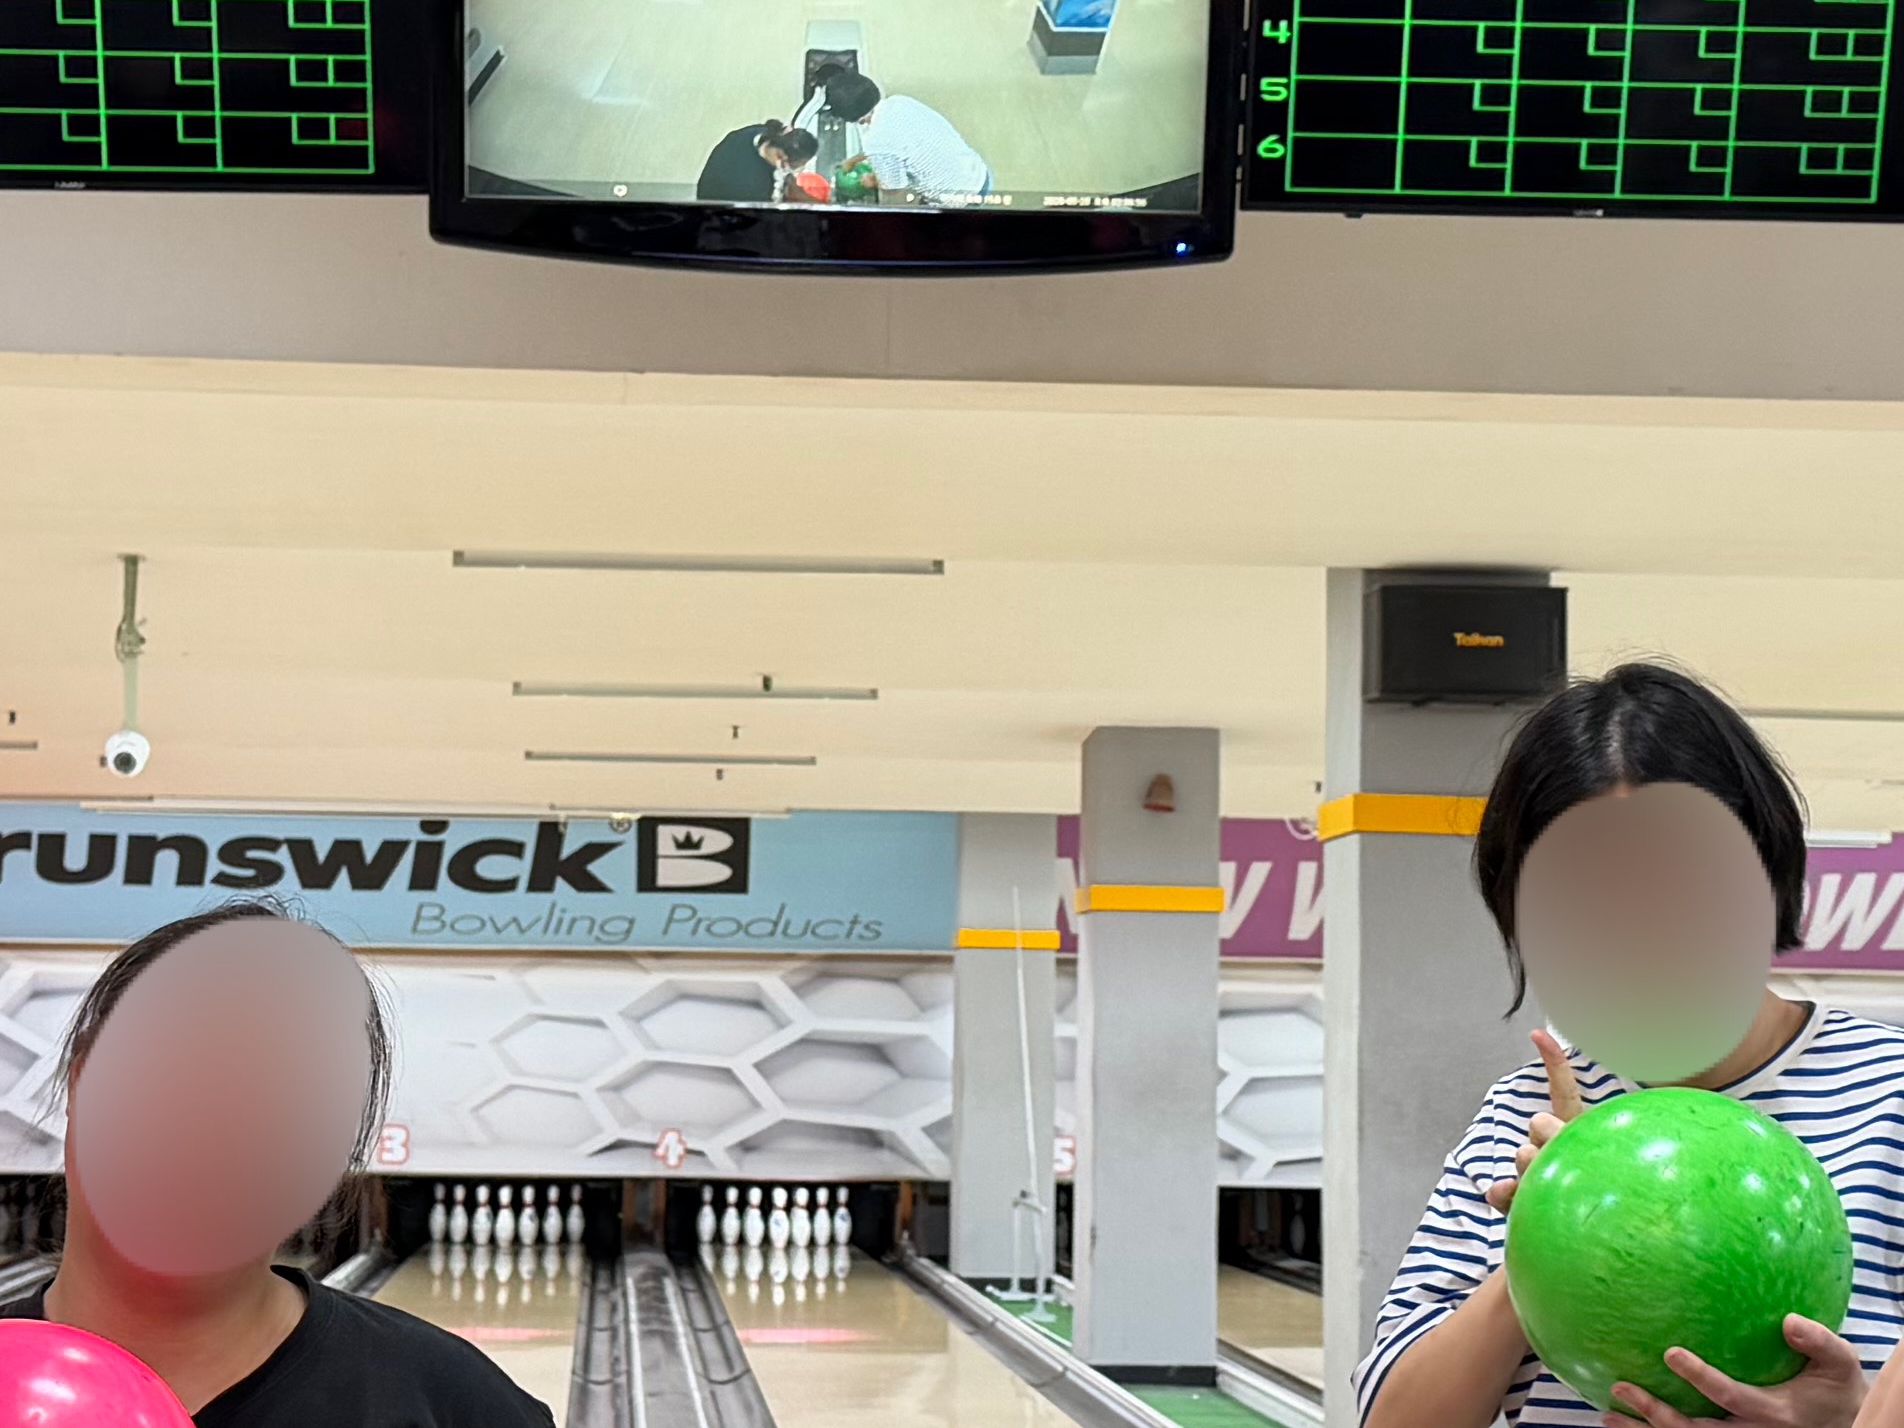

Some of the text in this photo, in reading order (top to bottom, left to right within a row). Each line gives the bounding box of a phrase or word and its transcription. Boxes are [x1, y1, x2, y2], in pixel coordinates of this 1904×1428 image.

[1262, 21, 1292, 45] 4
[1259, 77, 1289, 102] 5
[1257, 135, 1286, 159] 6
[410, 900, 884, 943] Bowling Products
[377, 1124, 410, 1164] 3
[652, 1128, 687, 1169] 4
